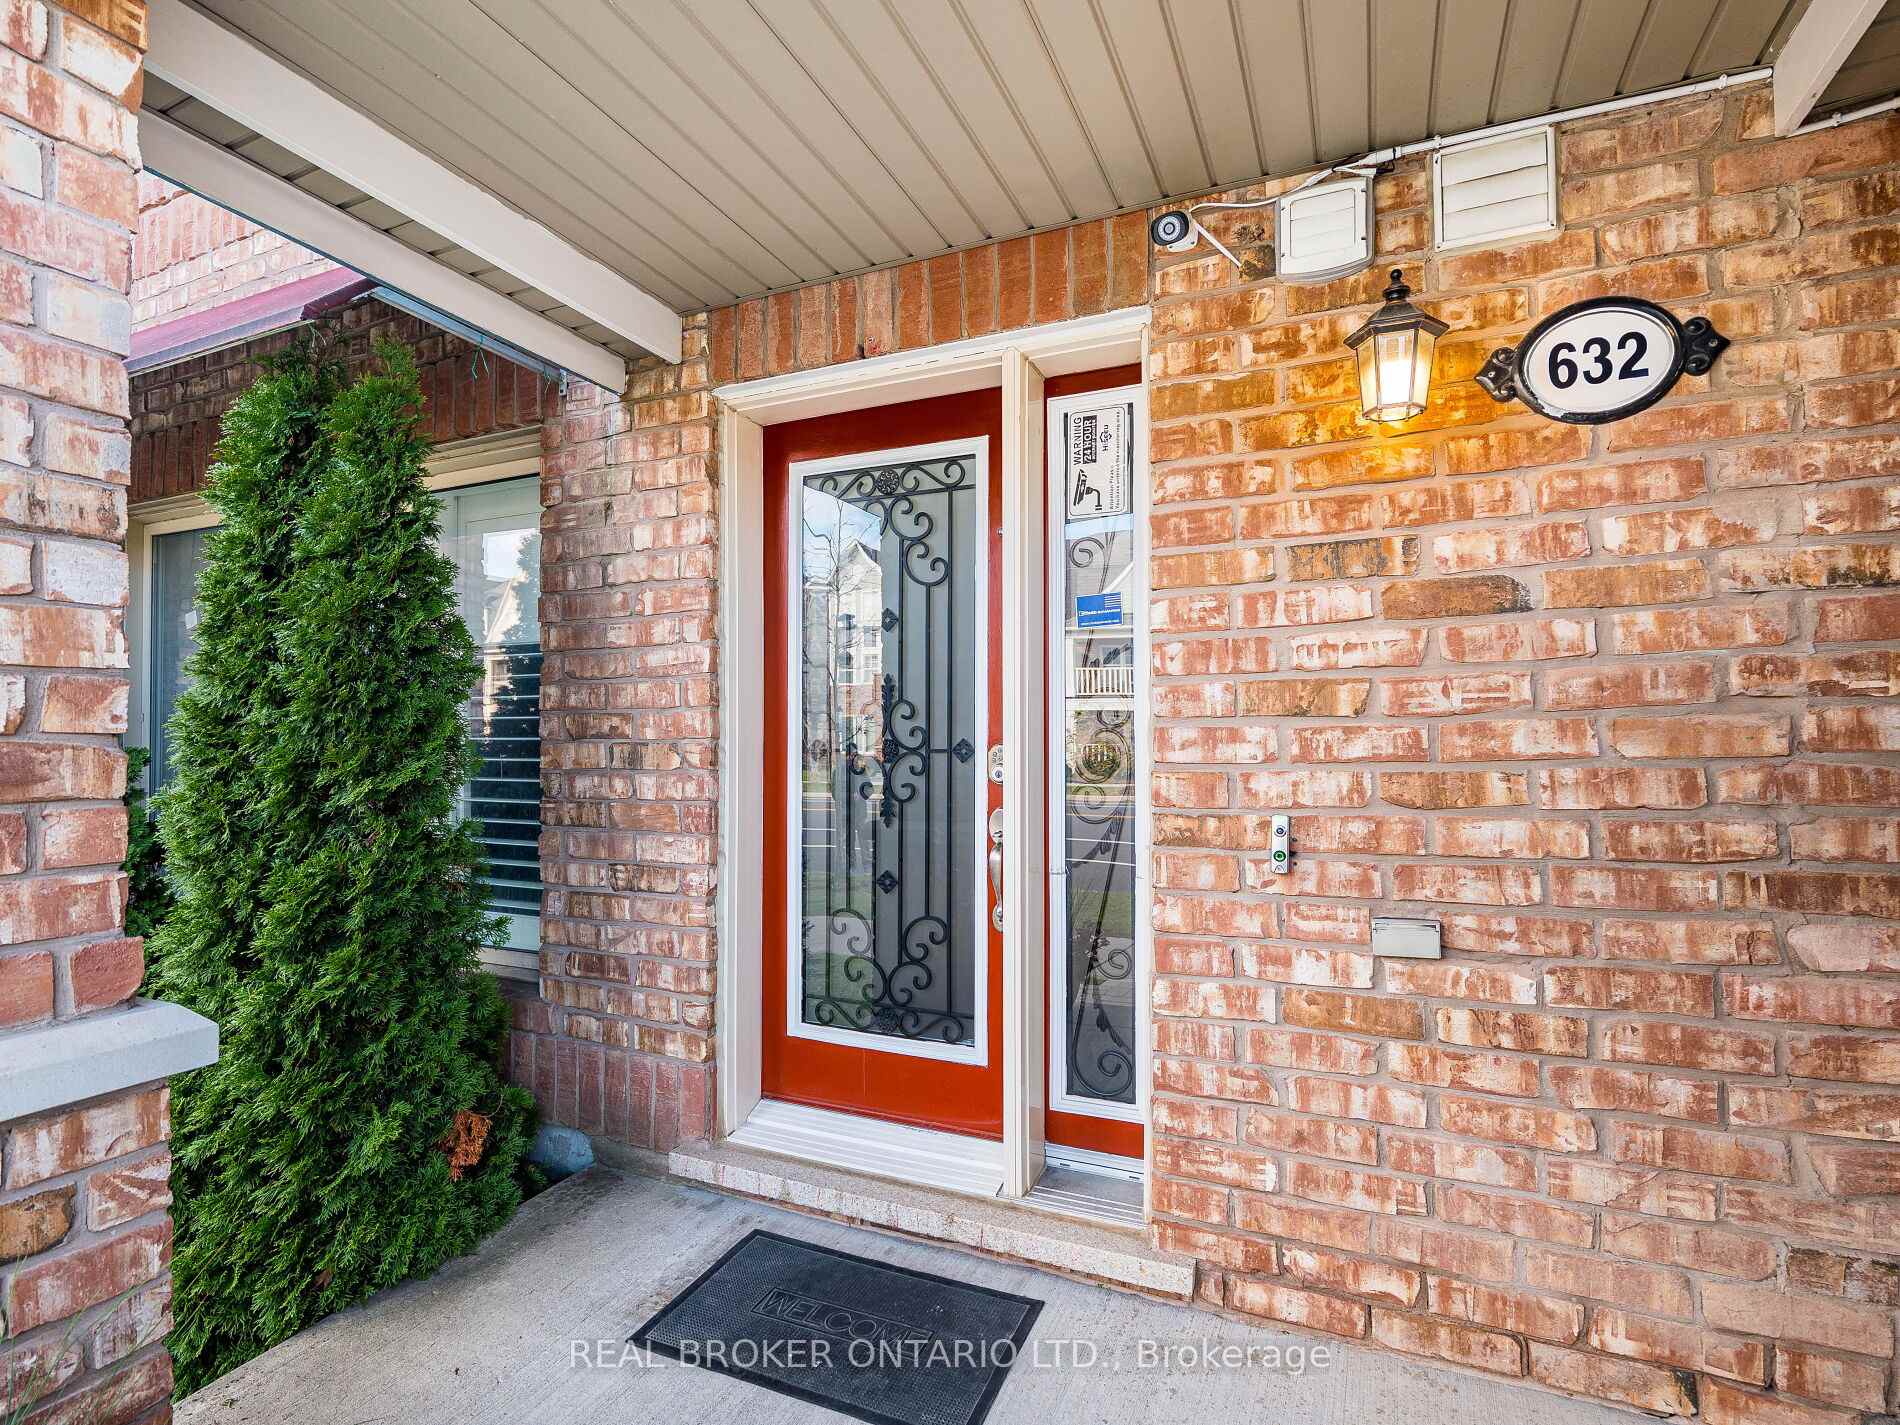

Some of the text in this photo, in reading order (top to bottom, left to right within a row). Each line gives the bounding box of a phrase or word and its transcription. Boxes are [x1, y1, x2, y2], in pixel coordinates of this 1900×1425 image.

[1548, 331, 1650, 390] 632
[1073, 416, 1082, 466] WARNING
[1083, 419, 1092, 461] 24 HOUR
[758, 1291, 933, 1361] WELCOME
